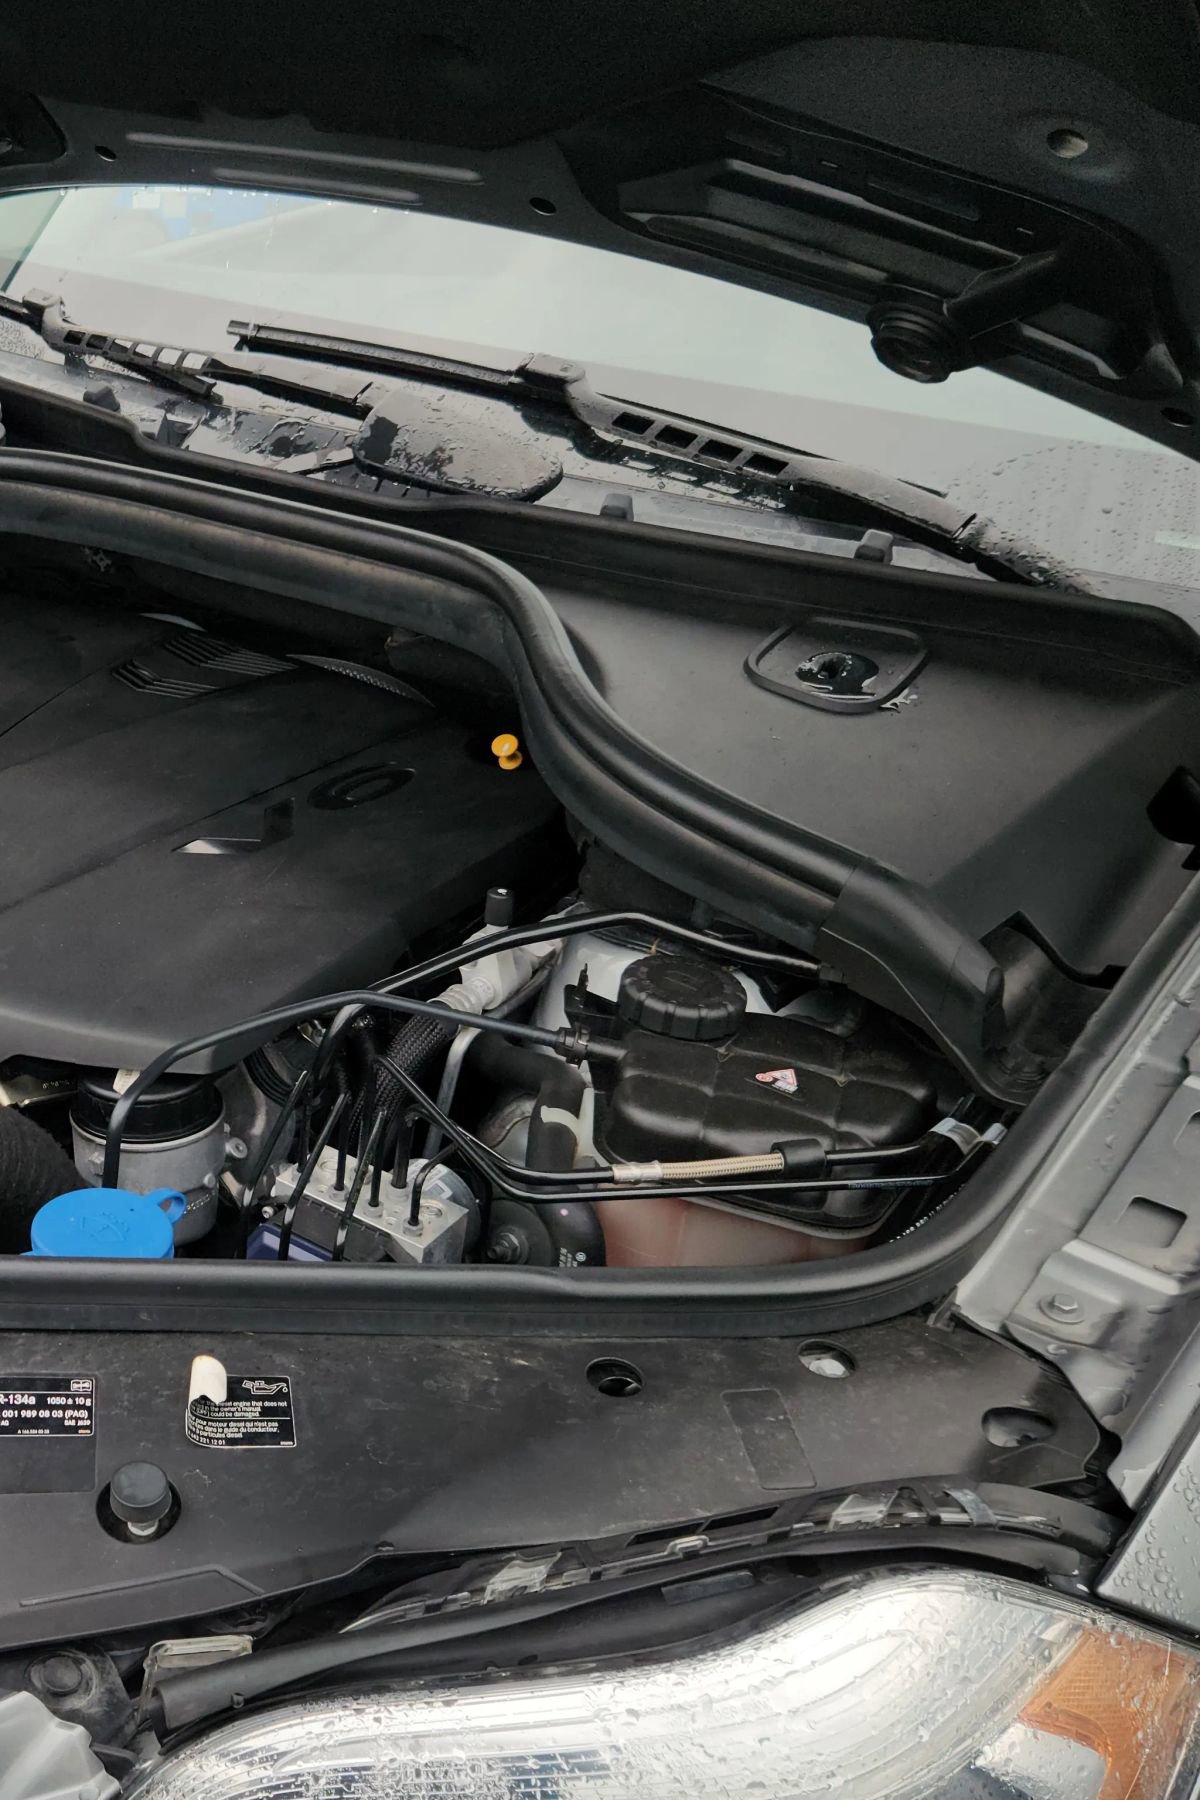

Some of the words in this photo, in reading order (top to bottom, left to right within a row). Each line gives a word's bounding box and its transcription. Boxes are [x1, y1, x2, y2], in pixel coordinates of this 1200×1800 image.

[46, 1396, 66, 1405] 1050
[75, 1397, 85, 1405] 10
[2, 1409, 18, 1418] 001
[20, 1409, 37, 1418] 989
[39, 1409, 50, 1418] 08
[51, 1409, 63, 1418] 03
[64, 1409, 89, 1419] (PAG)
